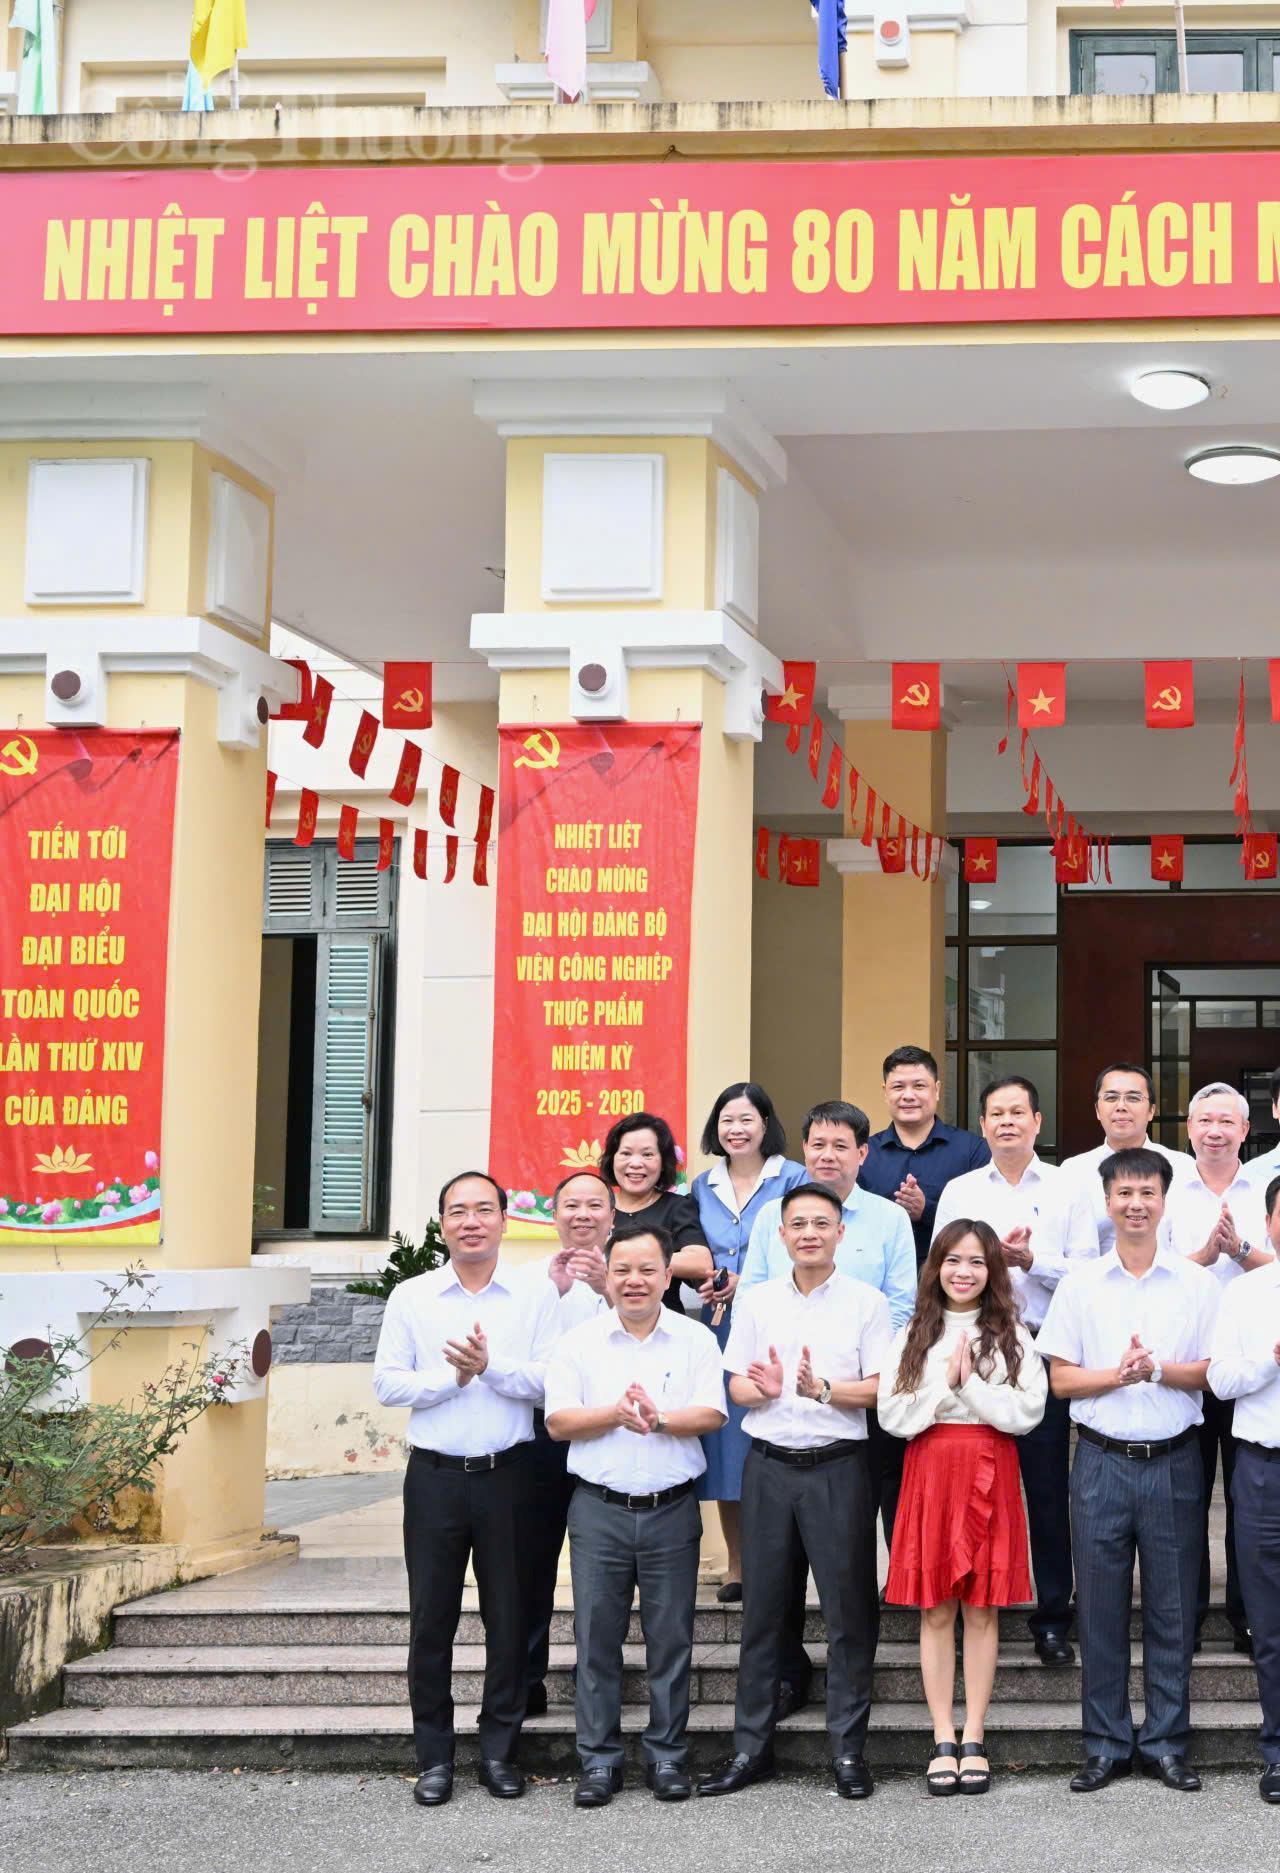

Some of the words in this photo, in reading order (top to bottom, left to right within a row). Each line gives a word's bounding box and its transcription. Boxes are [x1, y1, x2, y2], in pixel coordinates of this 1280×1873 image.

[44, 203, 224, 316] NHIỆT
[245, 202, 368, 315] LIỆT
[389, 200, 558, 298] CHÀO
[582, 198, 768, 295] MỪNG
[792, 208, 874, 293] 80
[898, 193, 1036, 291] NĂM
[1061, 191, 1232, 288] CÁCH
[28, 821, 79, 859] TIẾN
[87, 825, 126, 859] TỚI
[555, 820, 604, 852] NHIỆT
[608, 820, 642, 852] LIỆT
[546, 864, 592, 893] CHÀO
[597, 864, 648, 893] MỪNG
[30, 883, 70, 917] ĐẠI
[79, 878, 120, 917] HỘI
[523, 912, 552, 939] ĐẠI
[558, 907, 587, 941] HỘI
[593, 905, 639, 936] ĐẢNG
[645, 907, 667, 940] BỘ
[22, 936, 62, 970] ĐẠI
[71, 926, 125, 965] BIỂU
[517, 952, 554, 986] VIỆN
[559, 952, 606, 981] CÔNG
[612, 952, 672, 985] NGHIỆP
[2, 985, 64, 1018] TOÀN
[73, 979, 139, 1021] QUỐC
[543, 997, 589, 1029] THỰC
[594, 992, 643, 1025] PHẨM
[48, 1038, 98, 1071] THỨ
[101, 1042, 144, 1071] XIV
[552, 1041, 606, 1073] NHIỆM
[611, 1042, 633, 1070] KỲ
[5, 1089, 54, 1125] CỦA
[63, 1089, 127, 1125] ĐẢNG
[537, 1088, 581, 1115] 2025
[599, 1088, 644, 1115] 2030
